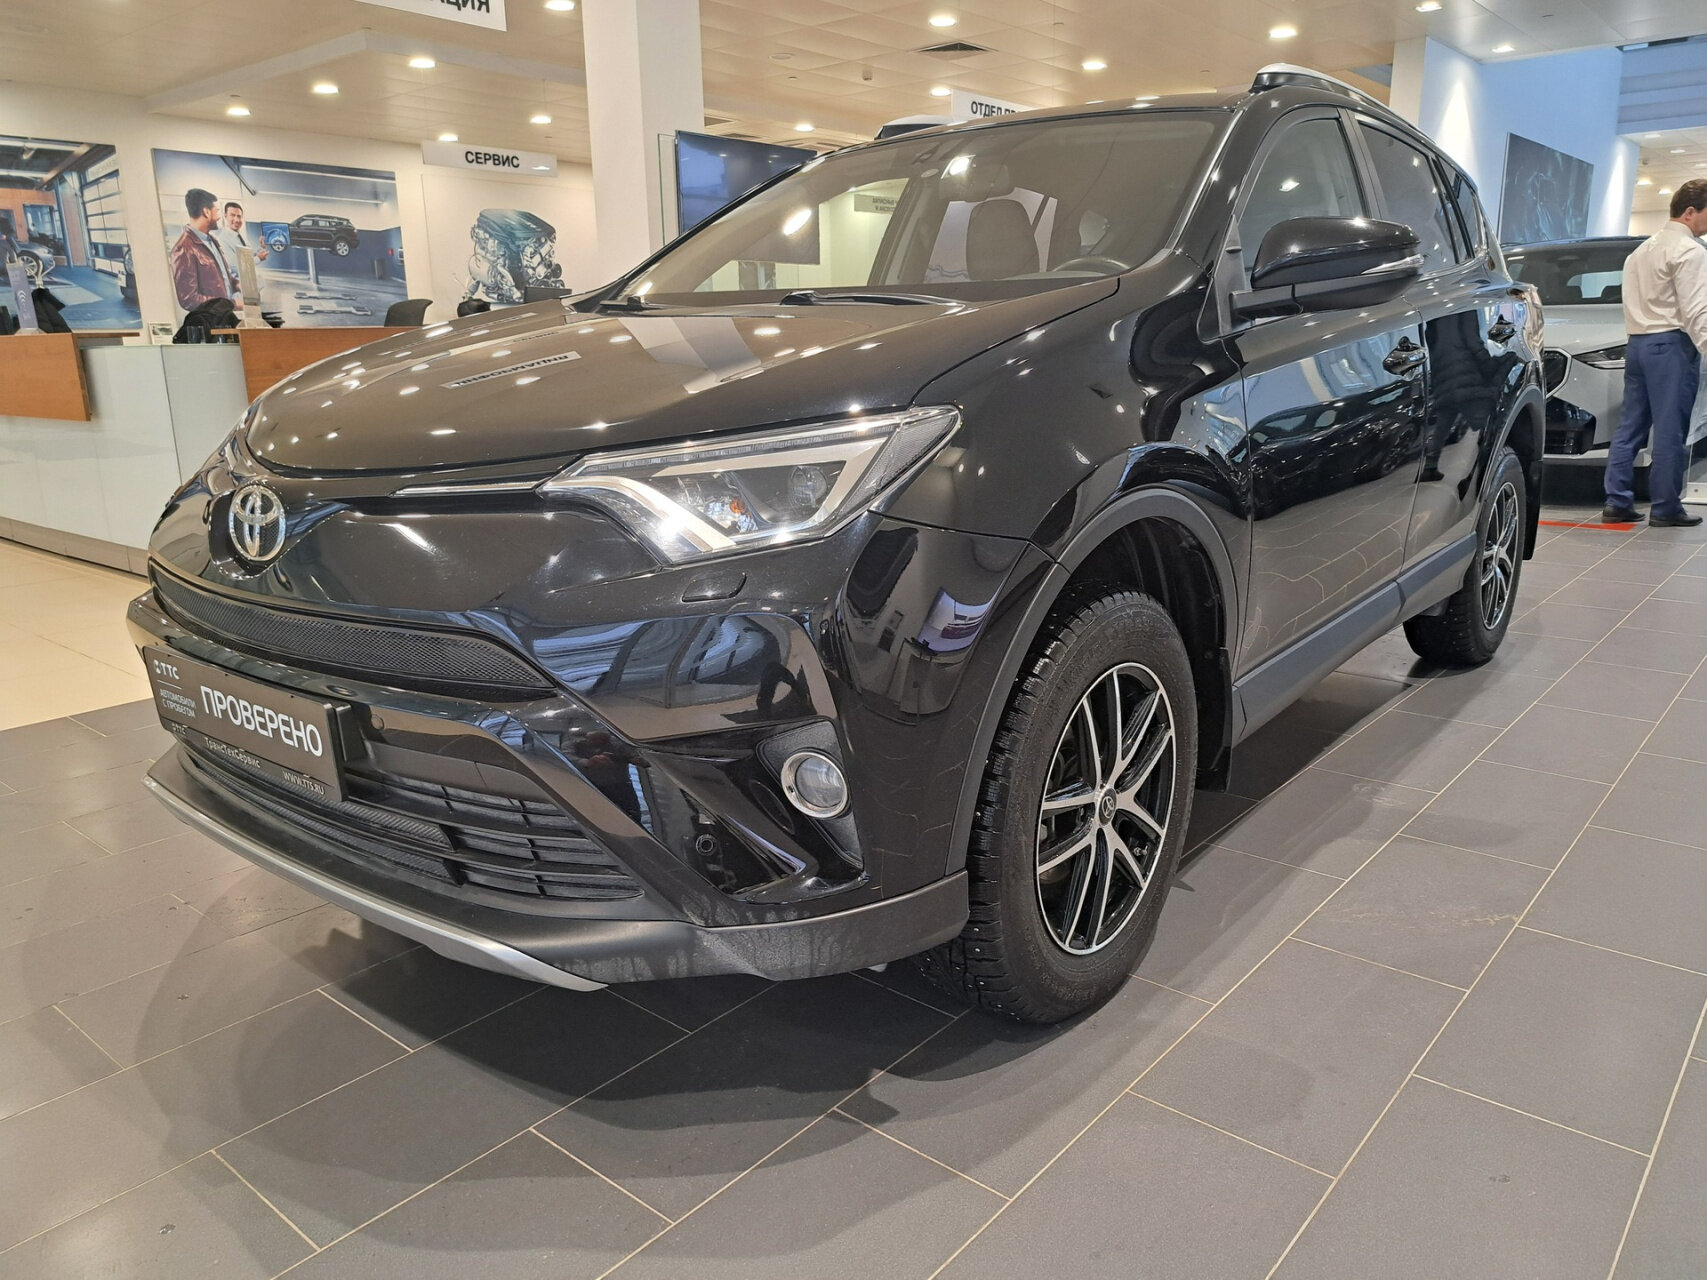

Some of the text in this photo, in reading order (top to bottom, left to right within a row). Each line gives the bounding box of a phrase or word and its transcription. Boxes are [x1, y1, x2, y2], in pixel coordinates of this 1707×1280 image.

[465, 151, 520, 168] СЕРВИС
[160, 688, 196, 709] АВТОМОБИЛИ
[167, 700, 196, 719] ПРОБЕГОМ
[200, 685, 323, 757] ПРОВЕРЕНО
[204, 736, 261, 768] ТрансТехСервис
